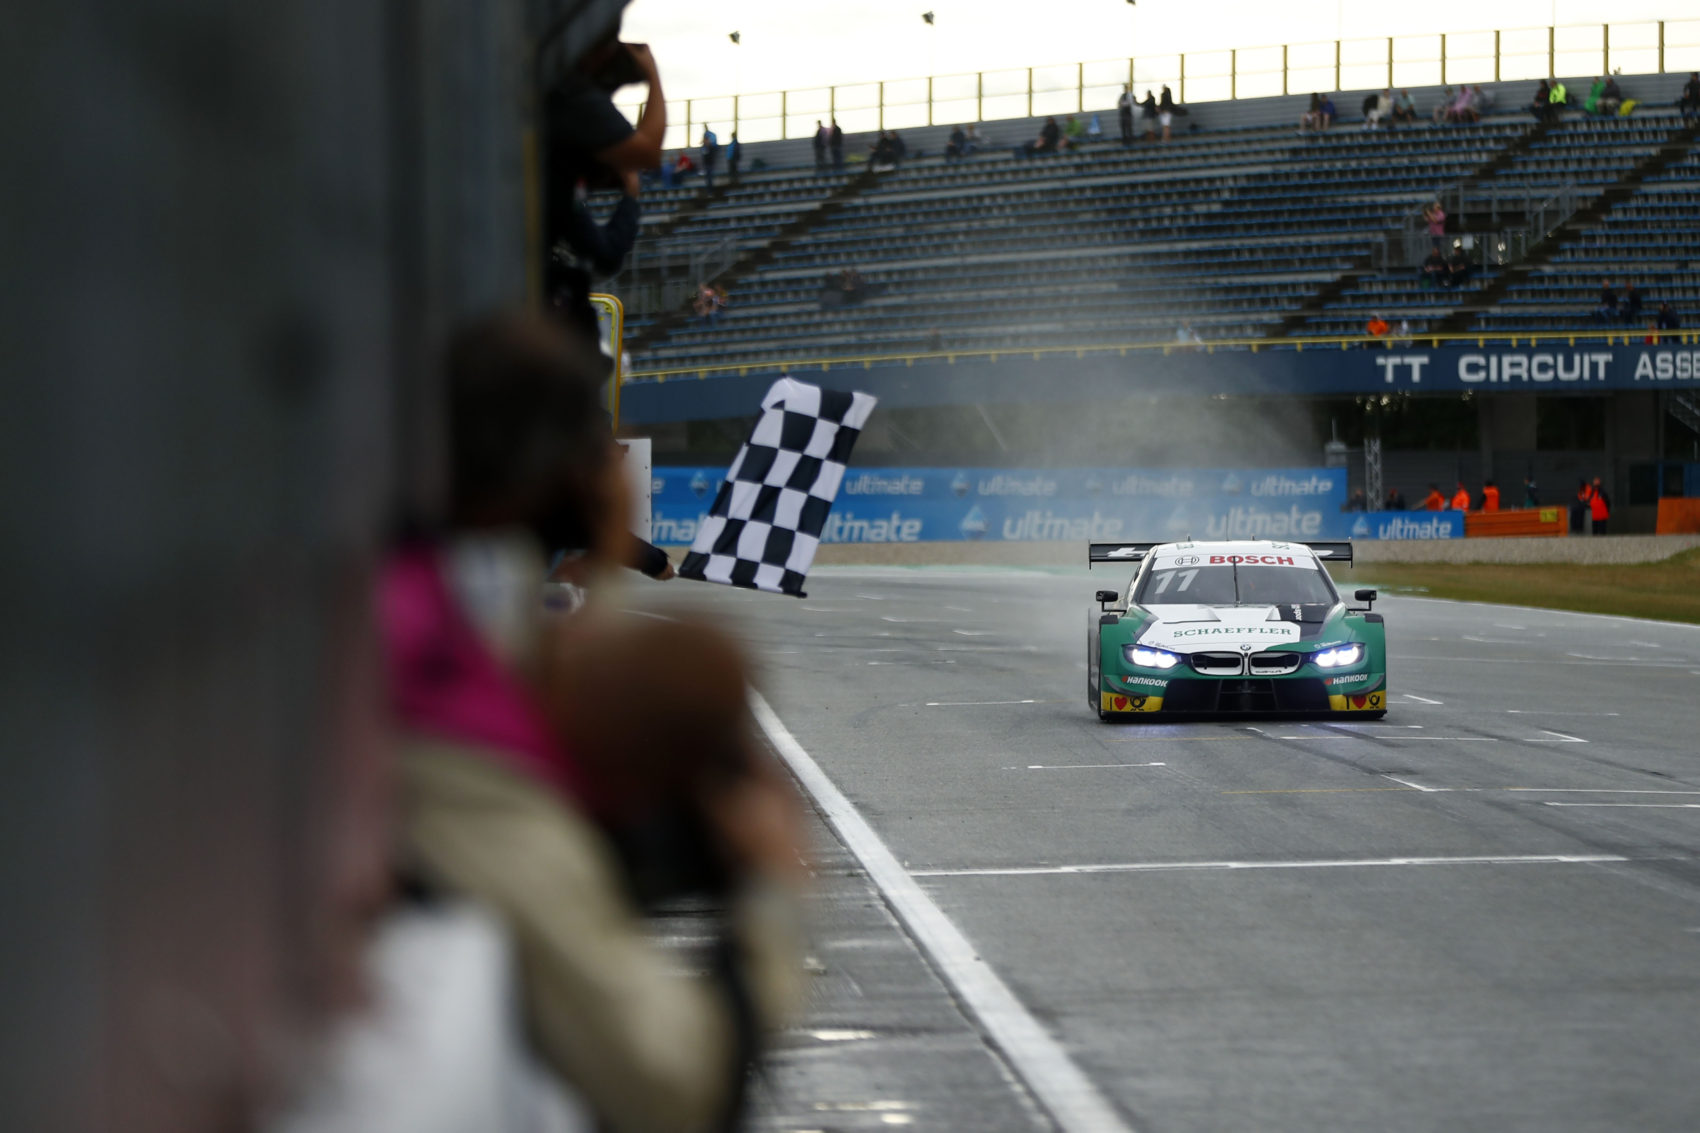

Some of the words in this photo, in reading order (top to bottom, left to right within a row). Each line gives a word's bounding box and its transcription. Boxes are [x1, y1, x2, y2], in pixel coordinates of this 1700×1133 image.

[1376, 355, 1429, 383] TT
[1458, 352, 1612, 382] CIRCUIT
[845, 474, 923, 495] ultimate
[977, 474, 1057, 496] ultimate
[1112, 475, 1194, 496] ultimate
[1251, 475, 1333, 497] ultimate
[821, 510, 923, 542] ltimate
[1002, 510, 1125, 540] ultimate
[1205, 504, 1322, 538] ultimate
[1378, 516, 1452, 540] ultimate
[1210, 555, 1294, 566] BOSCH
[1154, 568, 1200, 594] 11
[1173, 627, 1292, 638] SCHAEFFLER
